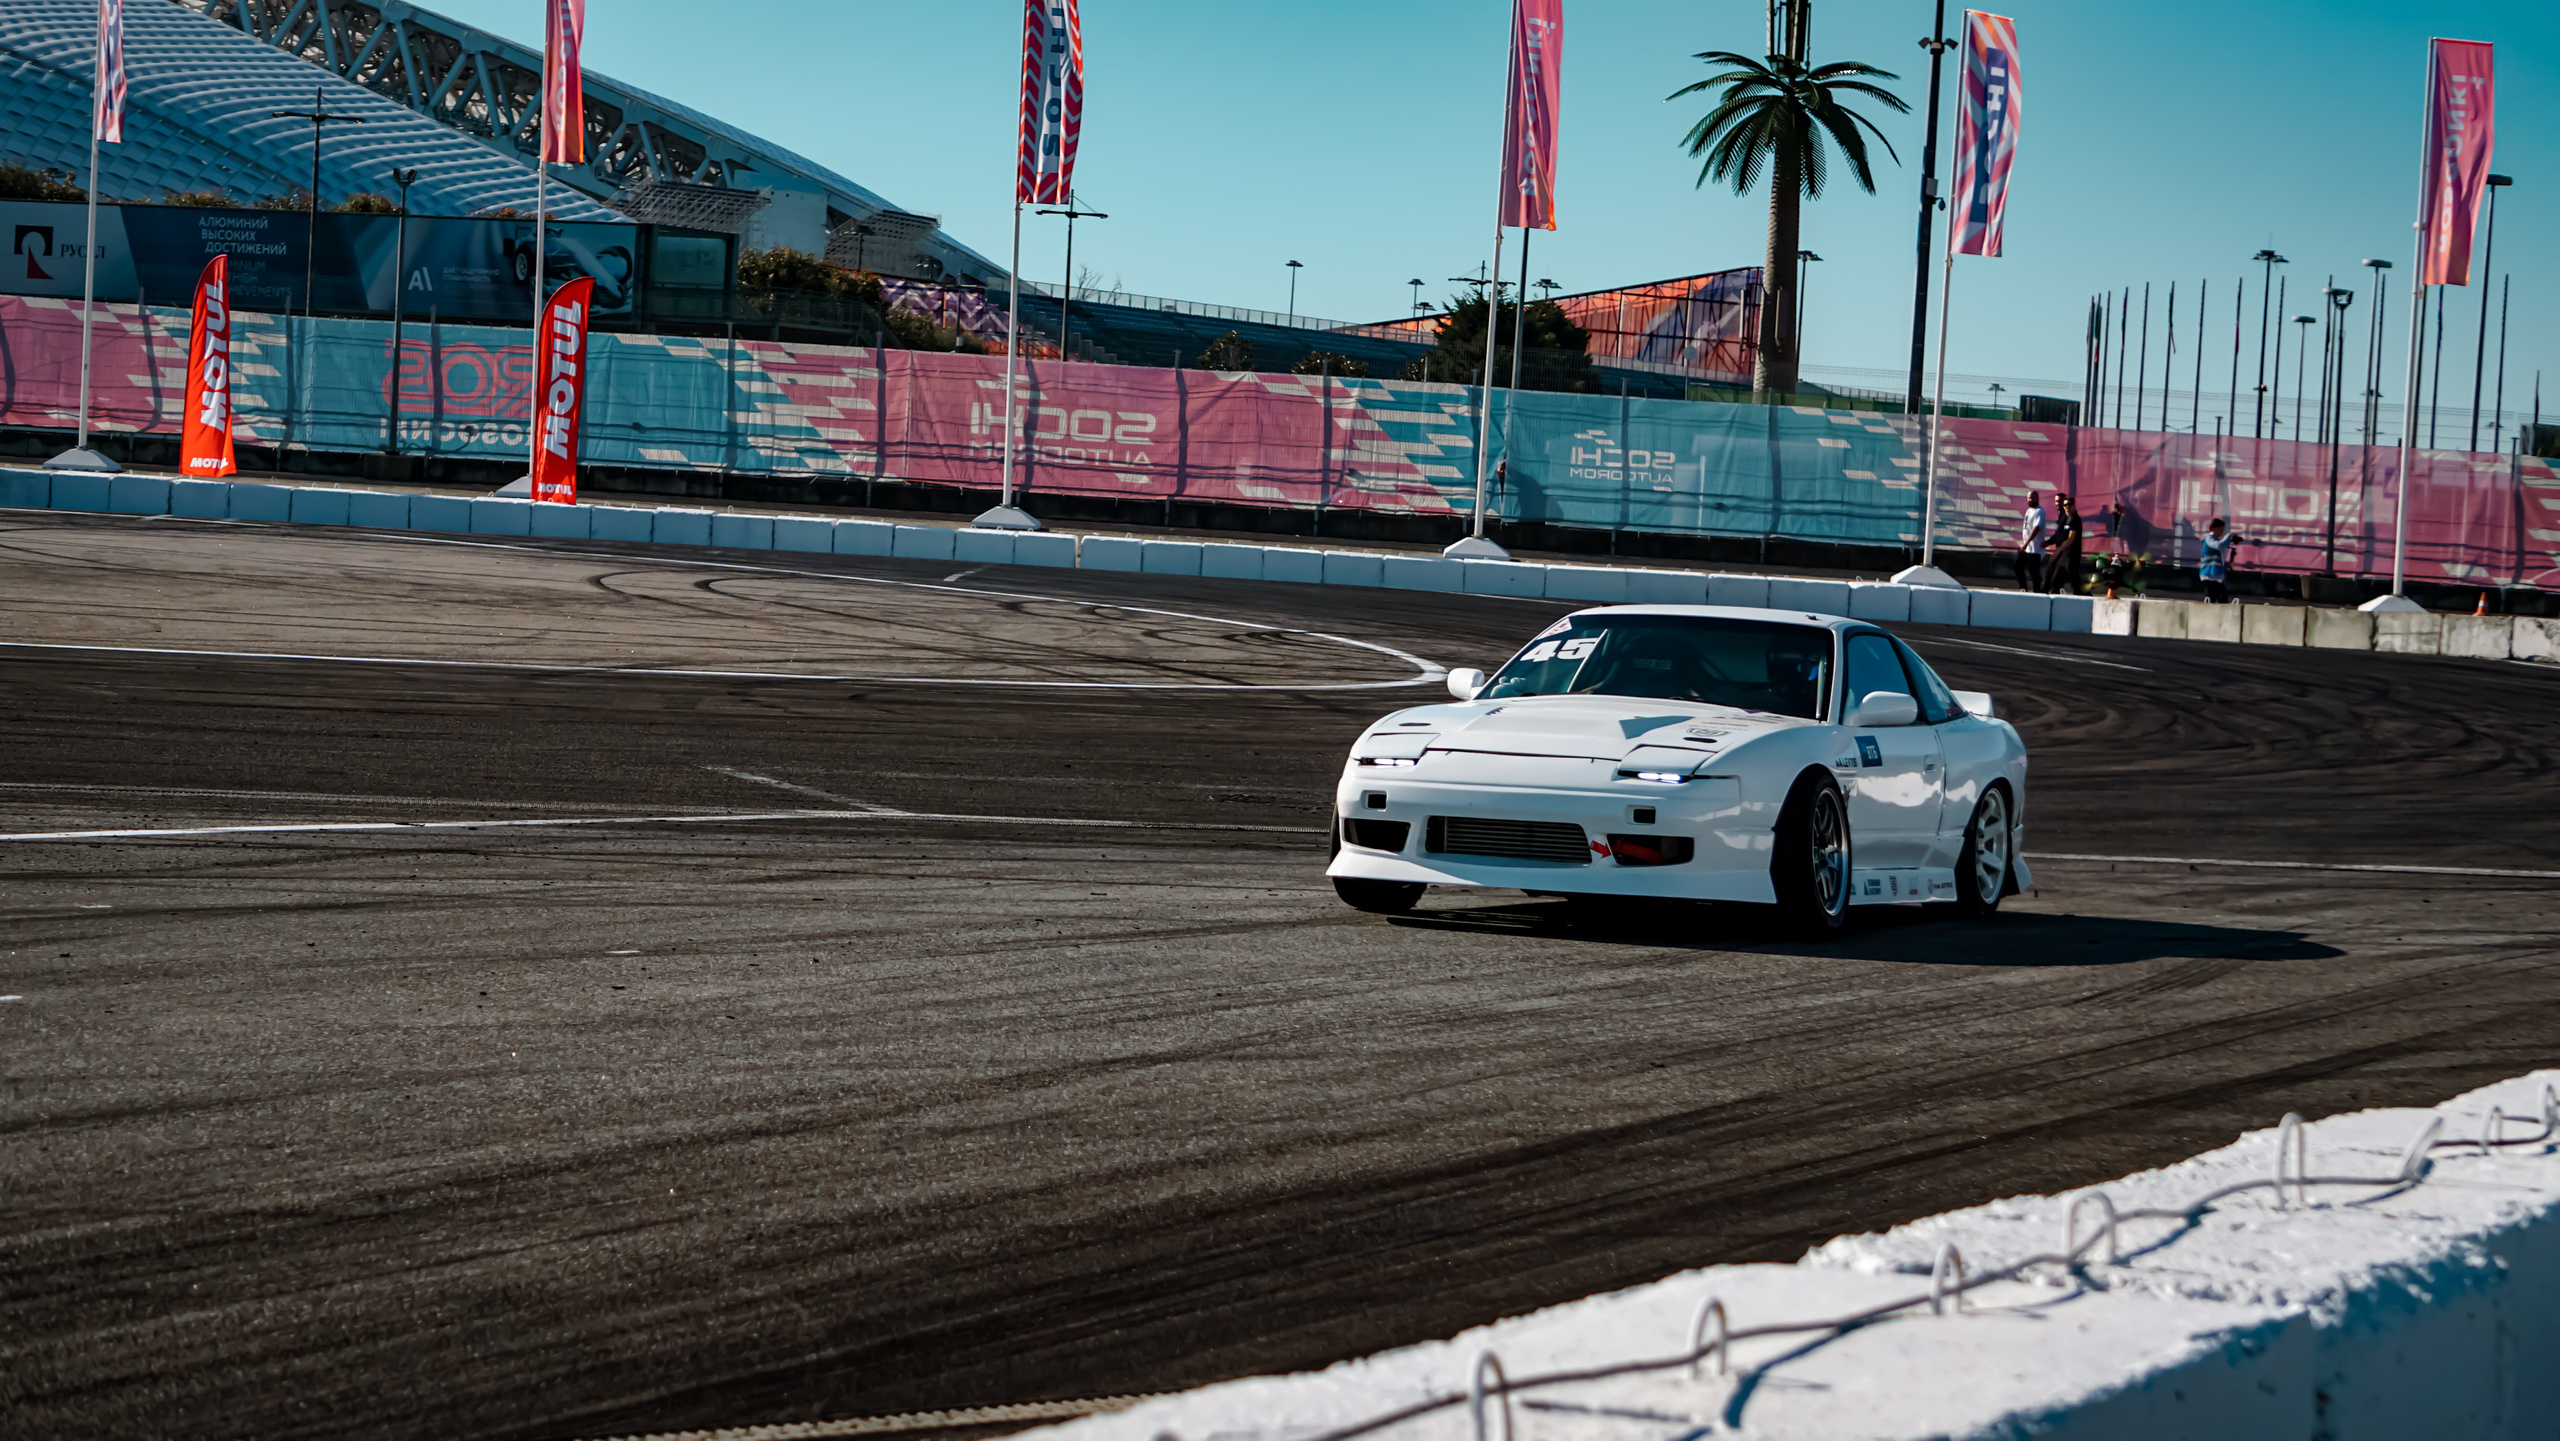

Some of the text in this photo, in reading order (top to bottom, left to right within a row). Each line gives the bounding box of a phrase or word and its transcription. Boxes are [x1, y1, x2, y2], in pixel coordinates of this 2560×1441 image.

[1042, 7, 1066, 158] SOCHI
[199, 216, 268, 229] АЛЮМИНИЙ
[201, 229, 256, 242] ВЫСОКИХ
[61, 244, 105, 259] РУСЛ
[204, 241, 287, 256] ДОСТИЖЕНИЙ
[200, 279, 228, 434] MOTUL
[543, 300, 582, 460] MOTUL
[190, 457, 228, 470] MOTUL
[537, 482, 573, 496] MOTUL
[1520, 637, 1599, 663] 45
